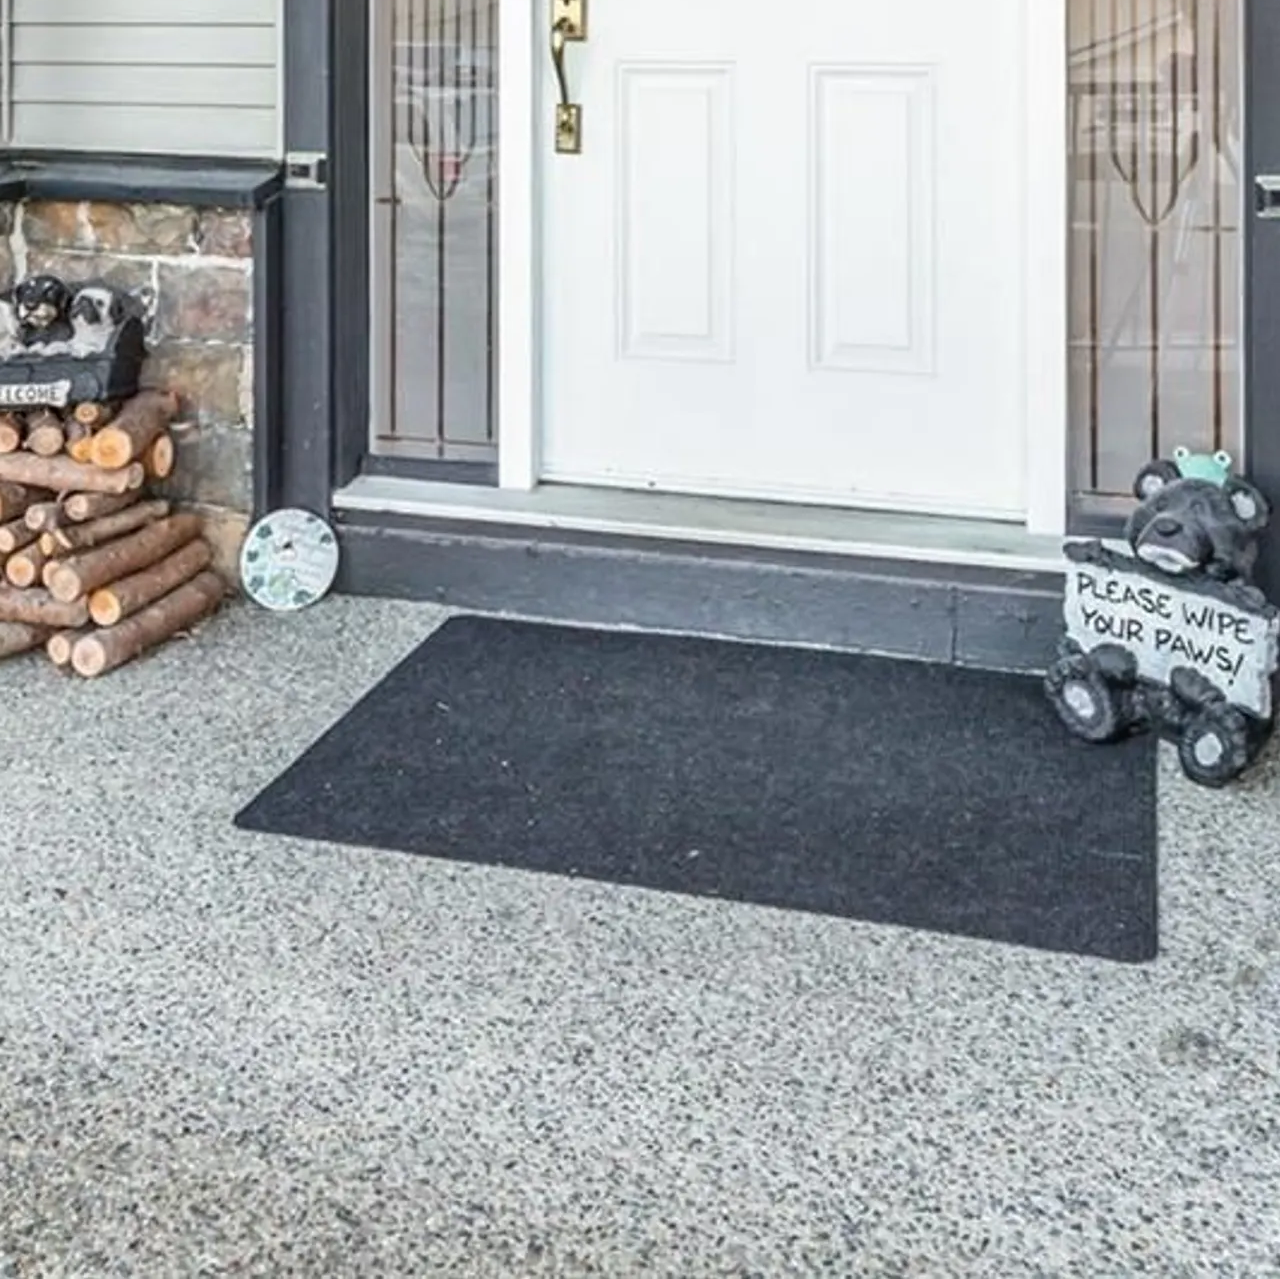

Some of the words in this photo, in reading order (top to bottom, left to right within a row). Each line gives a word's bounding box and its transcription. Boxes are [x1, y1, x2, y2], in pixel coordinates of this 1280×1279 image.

[1077, 572, 1172, 619] PLEASE
[1182, 602, 1255, 645] WIPE
[1081, 606, 1144, 643] YOUR
[1155, 628, 1245, 686] PAWS!
